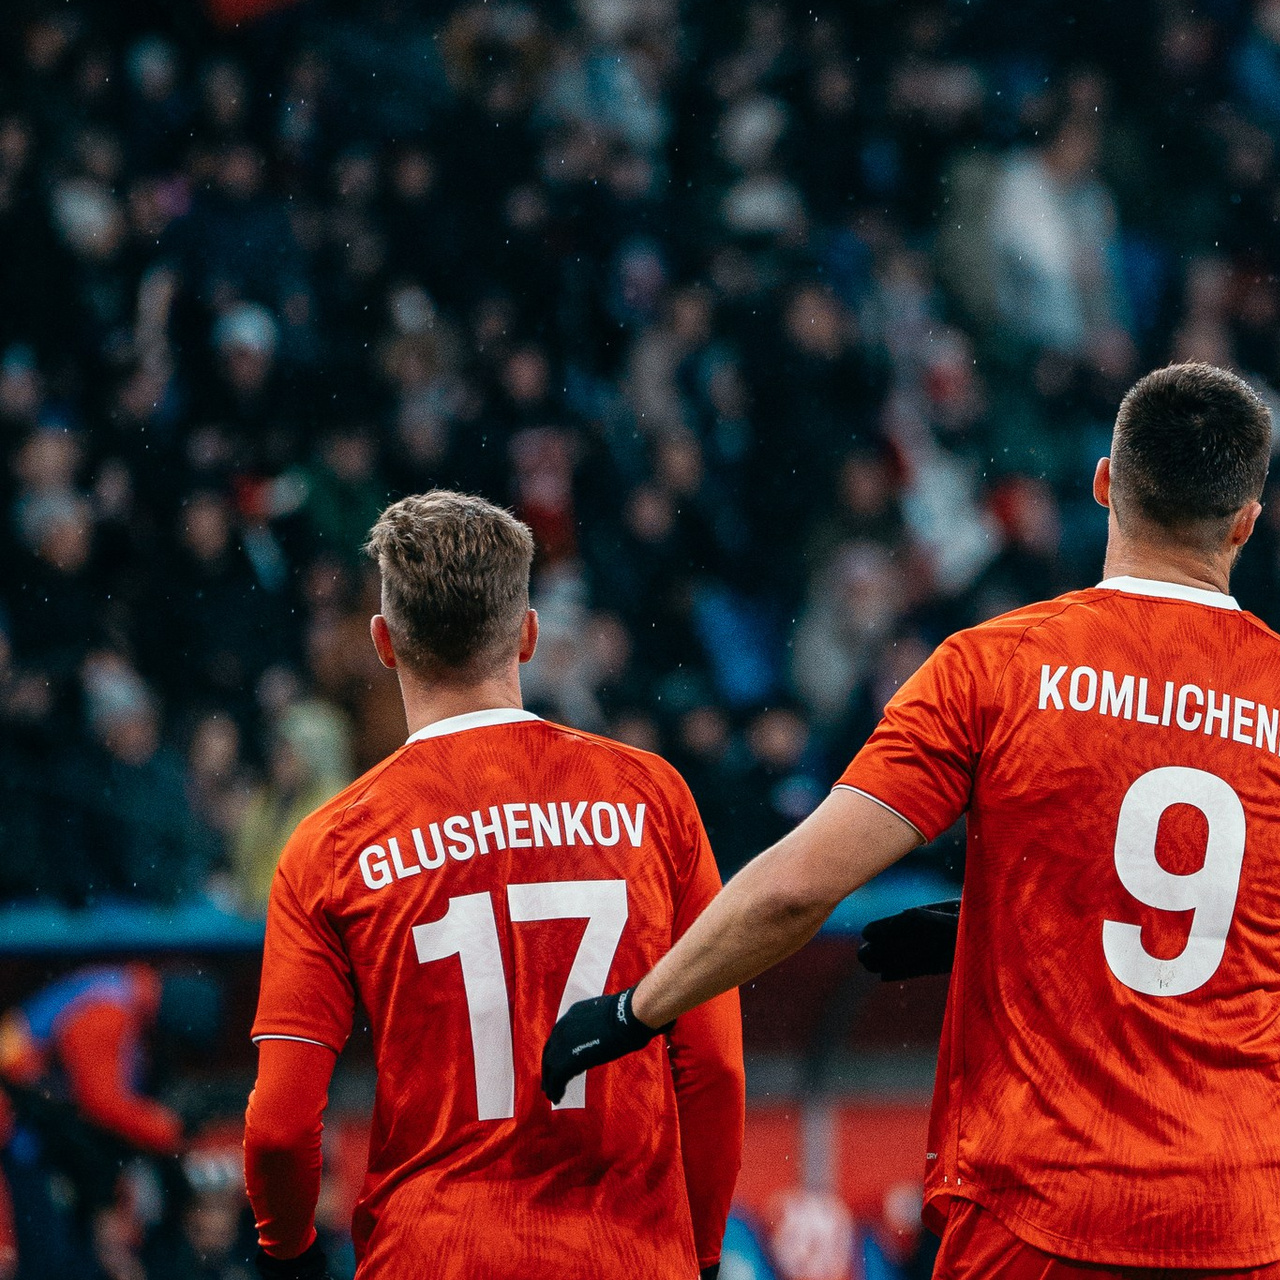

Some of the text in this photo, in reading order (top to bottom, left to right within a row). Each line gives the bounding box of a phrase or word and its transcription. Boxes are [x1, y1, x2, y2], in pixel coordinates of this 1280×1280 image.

[358, 801, 646, 890] GLUSHENKOV
[1101, 765, 1248, 998] 9
[411, 878, 630, 1122] 17
